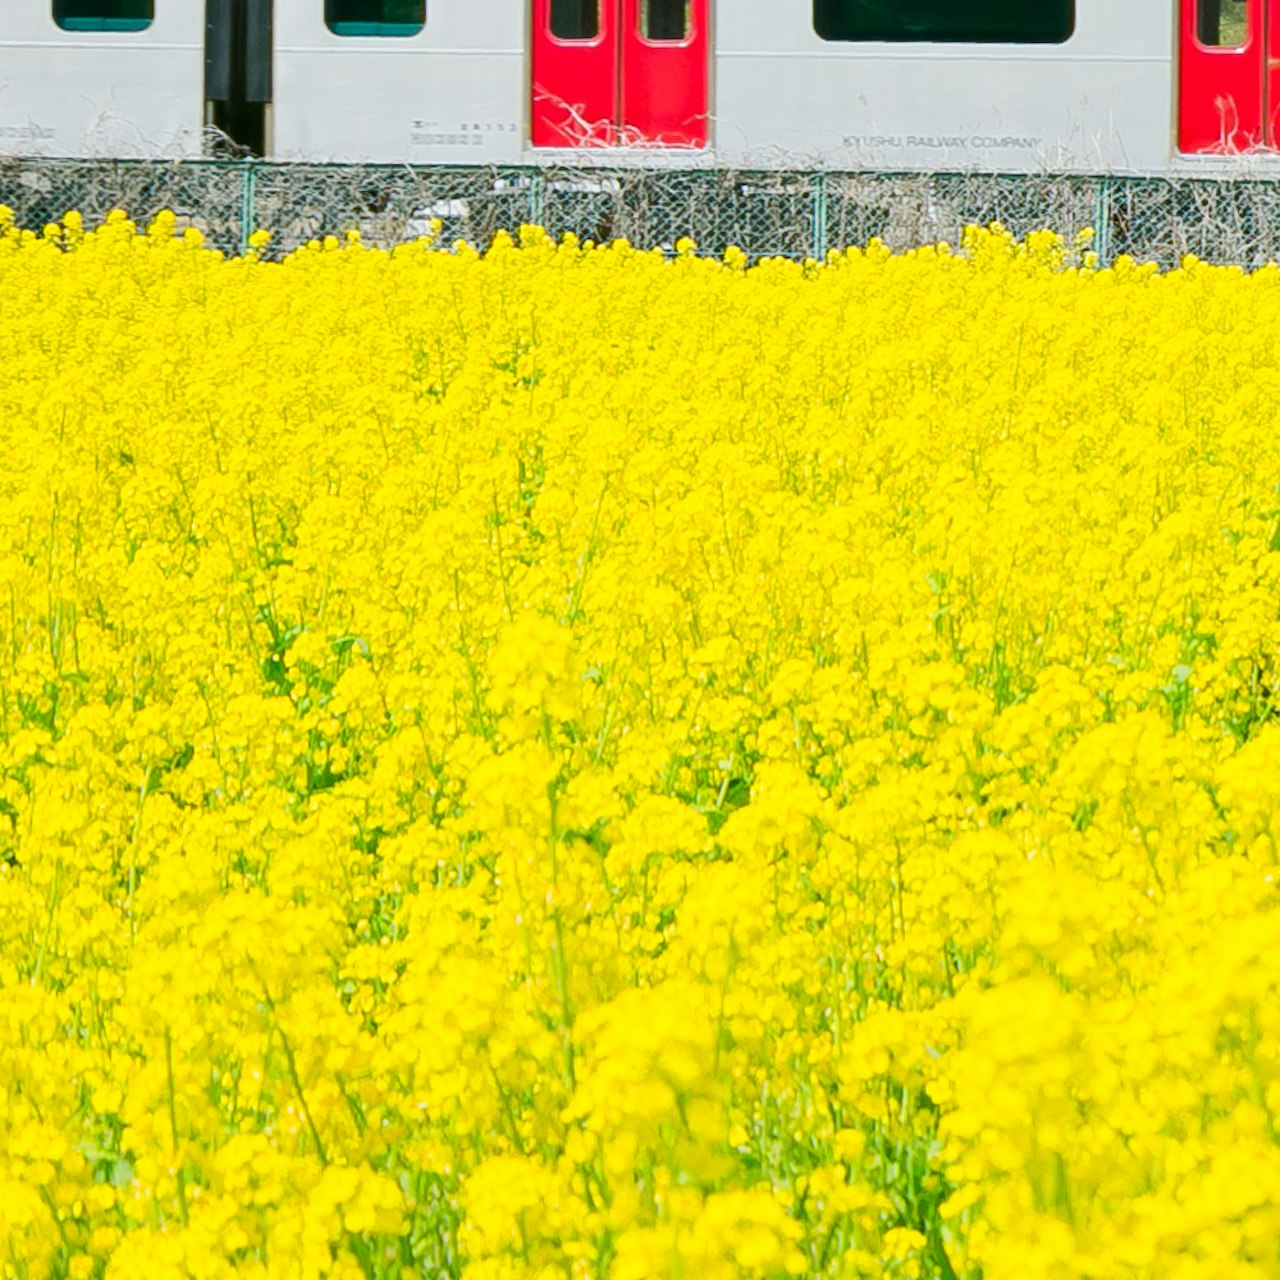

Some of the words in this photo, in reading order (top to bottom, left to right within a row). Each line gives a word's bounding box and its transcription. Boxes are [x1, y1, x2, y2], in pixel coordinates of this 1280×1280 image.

[843, 136, 902, 147] KYUSHU
[907, 136, 968, 148] RAILWAY
[971, 136, 1042, 149] COMPANY
